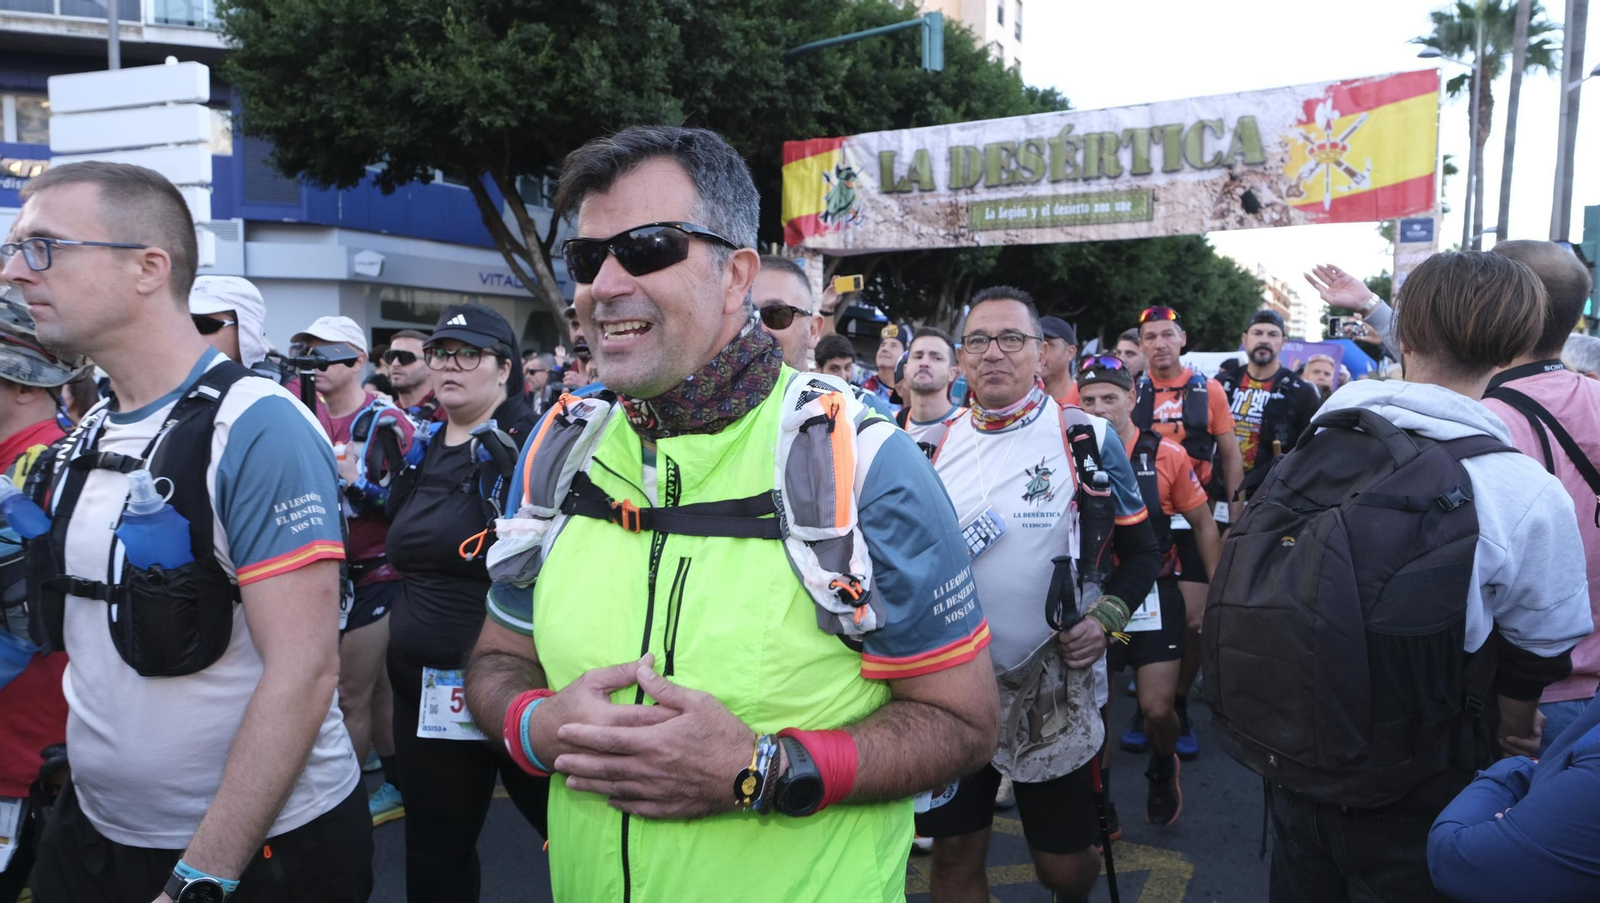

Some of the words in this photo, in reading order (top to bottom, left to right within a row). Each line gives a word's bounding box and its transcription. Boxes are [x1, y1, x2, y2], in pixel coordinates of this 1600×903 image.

[878, 148, 936, 194] LA
[948, 115, 1267, 190] DESÉRTICA
[985, 207, 996, 221] La
[998, 205, 1028, 221] Legión
[1031, 207, 1038, 219] y
[1041, 203, 1051, 217] el
[1053, 203, 1092, 216] desierto
[1094, 202, 1111, 214] nos
[1114, 200, 1132, 212] une
[273, 502, 288, 514] LA
[275, 516, 289, 526] EL
[290, 520, 310, 535] NOS
[933, 586, 945, 600] LA
[933, 602, 946, 616] EL
[944, 608, 965, 626] NOS
